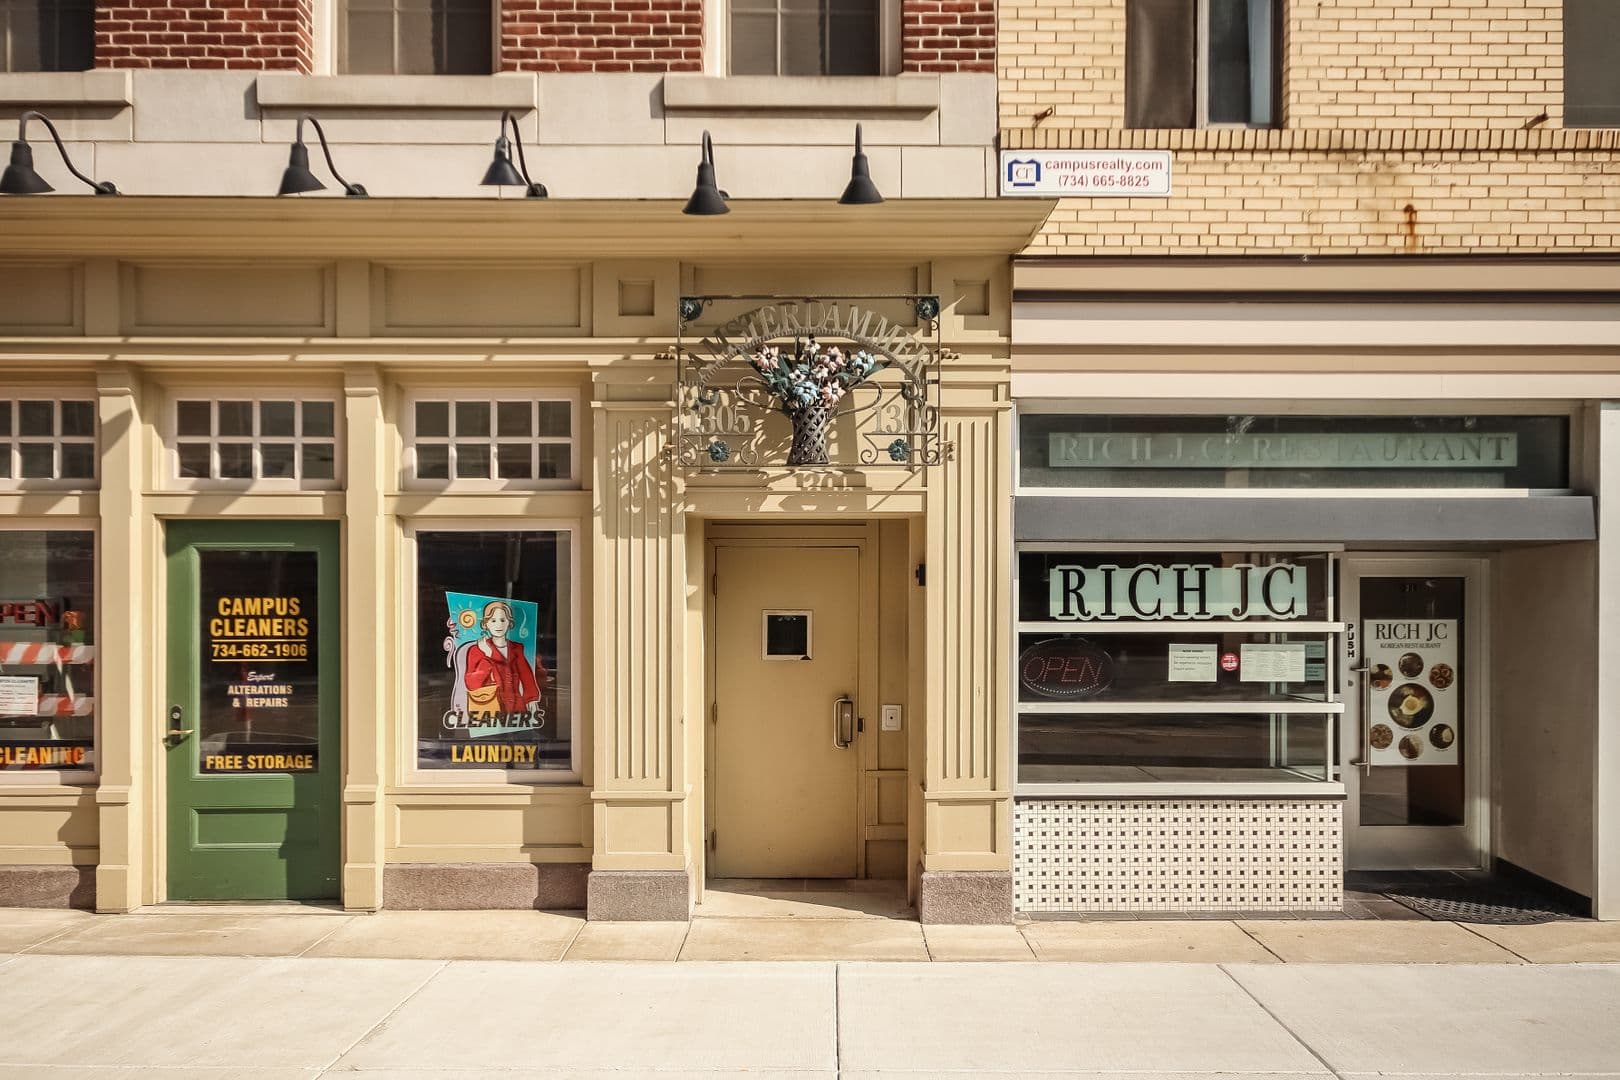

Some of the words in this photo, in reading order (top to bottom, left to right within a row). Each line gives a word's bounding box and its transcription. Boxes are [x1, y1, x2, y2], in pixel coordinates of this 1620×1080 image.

[1045, 159, 1163, 173] campusrealty.com
[1058, 175, 1089, 187] (734)
[1092, 175, 1150, 187] 665-8825
[872, 404, 938, 434] 1309
[1057, 436, 1152, 461] RICH
[1252, 435, 1510, 461] RESTAURANT
[1057, 565, 1213, 617] RICH
[1231, 565, 1296, 617] JC
[217, 597, 301, 616] CAMPUS
[209, 618, 309, 636] CLEANERS
[1375, 623, 1420, 640] RICH
[1426, 622, 1448, 641] JC
[1347, 623, 1355, 657] PUSH
[211, 644, 308, 657] 734-662-1906
[246, 671, 275, 683] Expert
[1023, 656, 1104, 682] OPEN
[227, 685, 293, 695] ALTERATIONS
[232, 698, 240, 707] &
[246, 698, 288, 707] REPAIRS
[444, 710, 545, 728] CLEANERS
[206, 755, 243, 769] FREE
[246, 755, 313, 769] STORAGE
[451, 745, 537, 763] LAUNDRY
